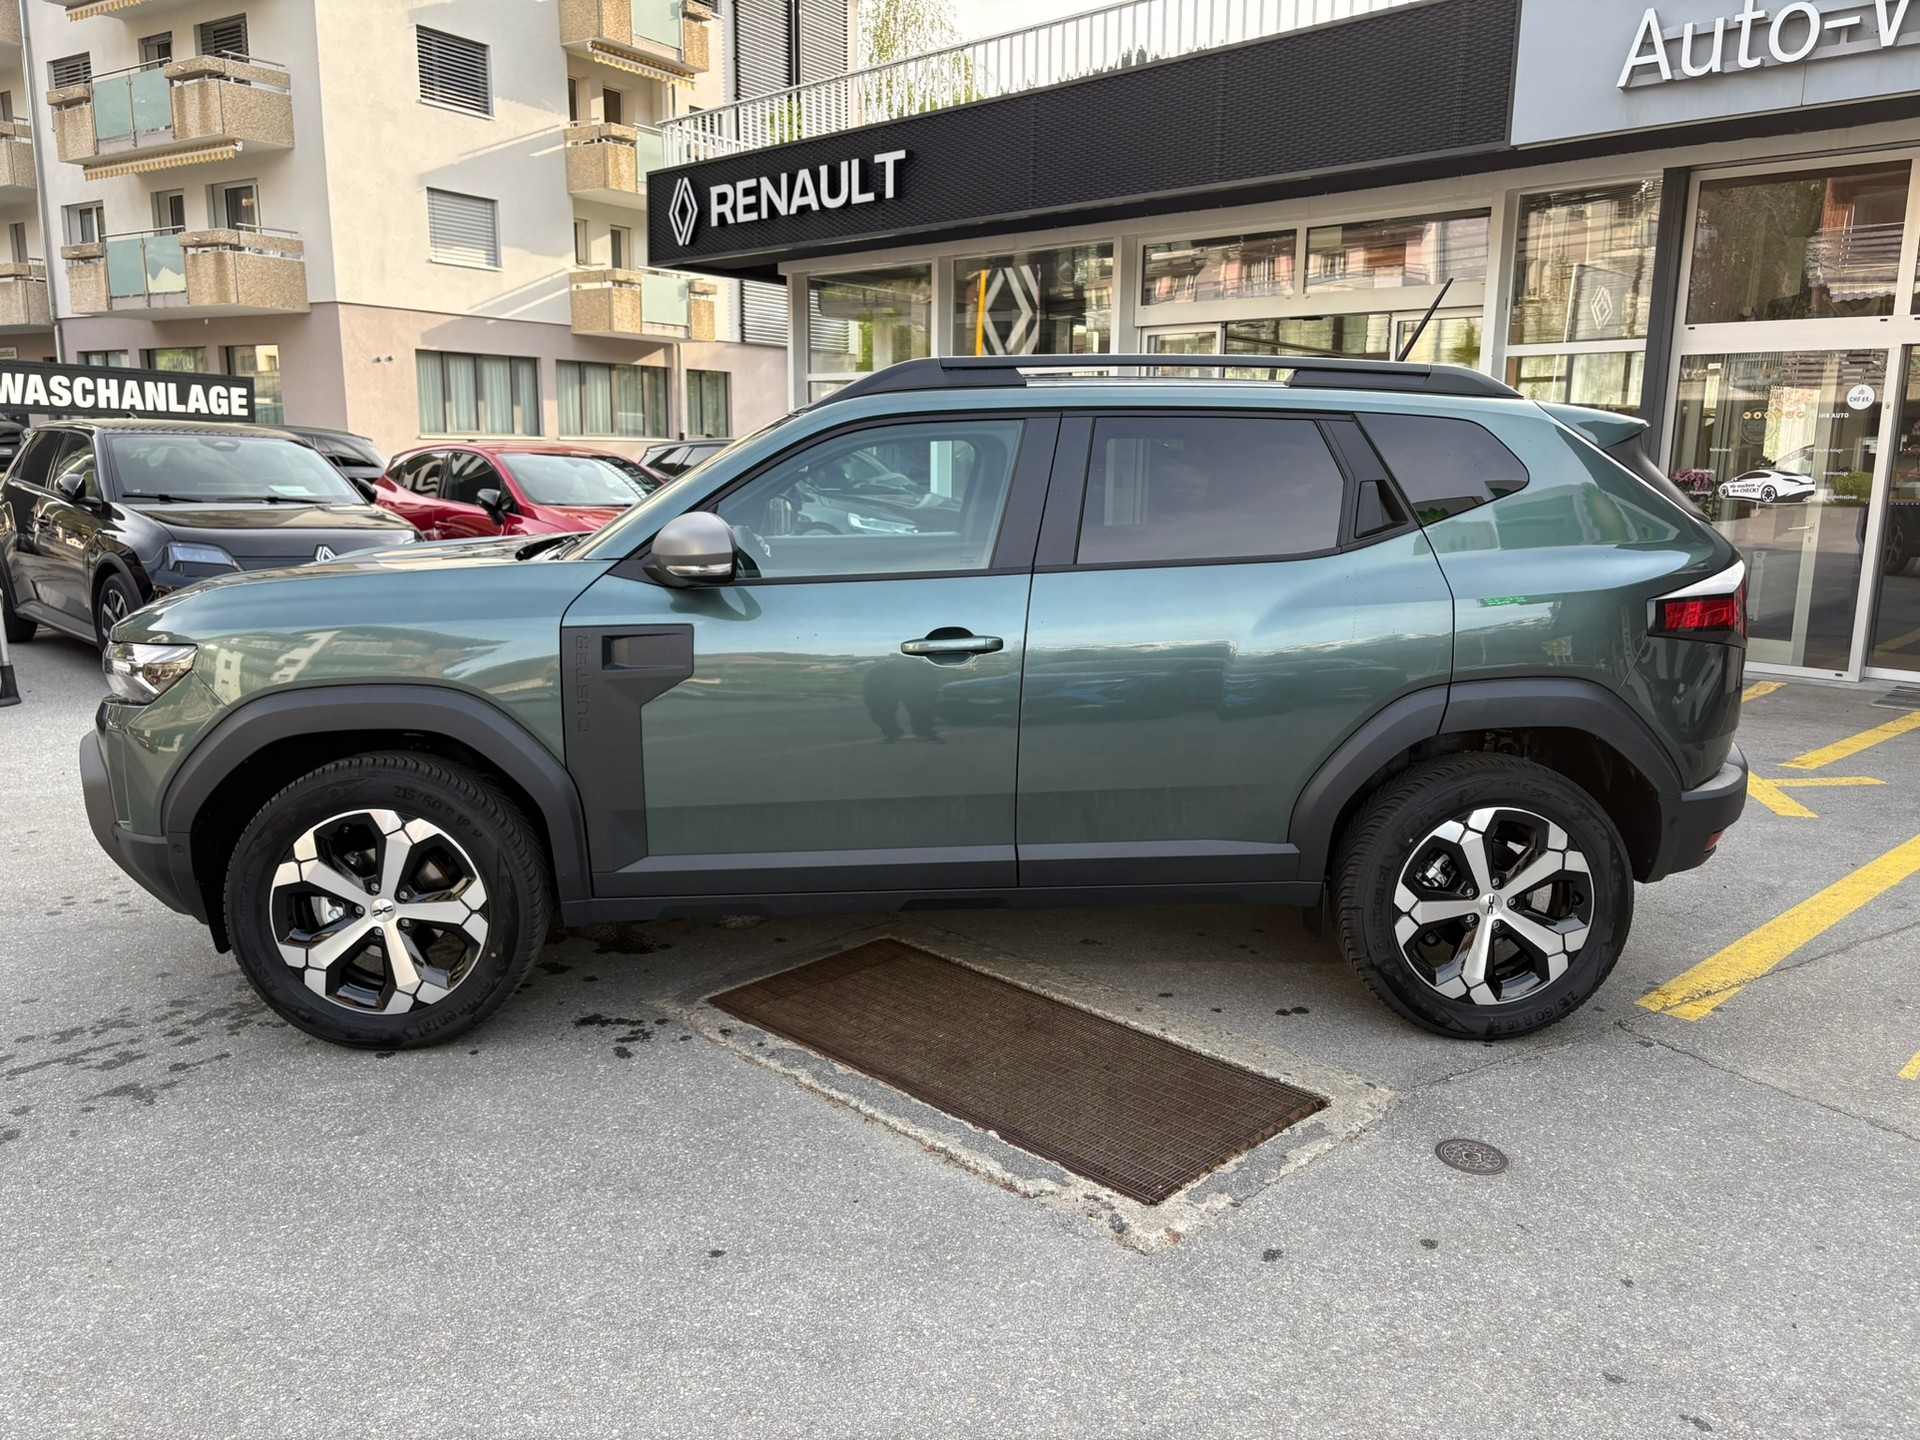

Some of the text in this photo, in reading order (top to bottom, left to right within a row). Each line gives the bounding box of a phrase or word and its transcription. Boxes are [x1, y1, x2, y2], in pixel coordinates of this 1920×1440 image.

[1616, 0, 1910, 90] Auto-V
[709, 150, 906, 227] RENAULT
[0, 372, 249, 416] WASCHANLAGE
[574, 634, 591, 733] DUSTER
